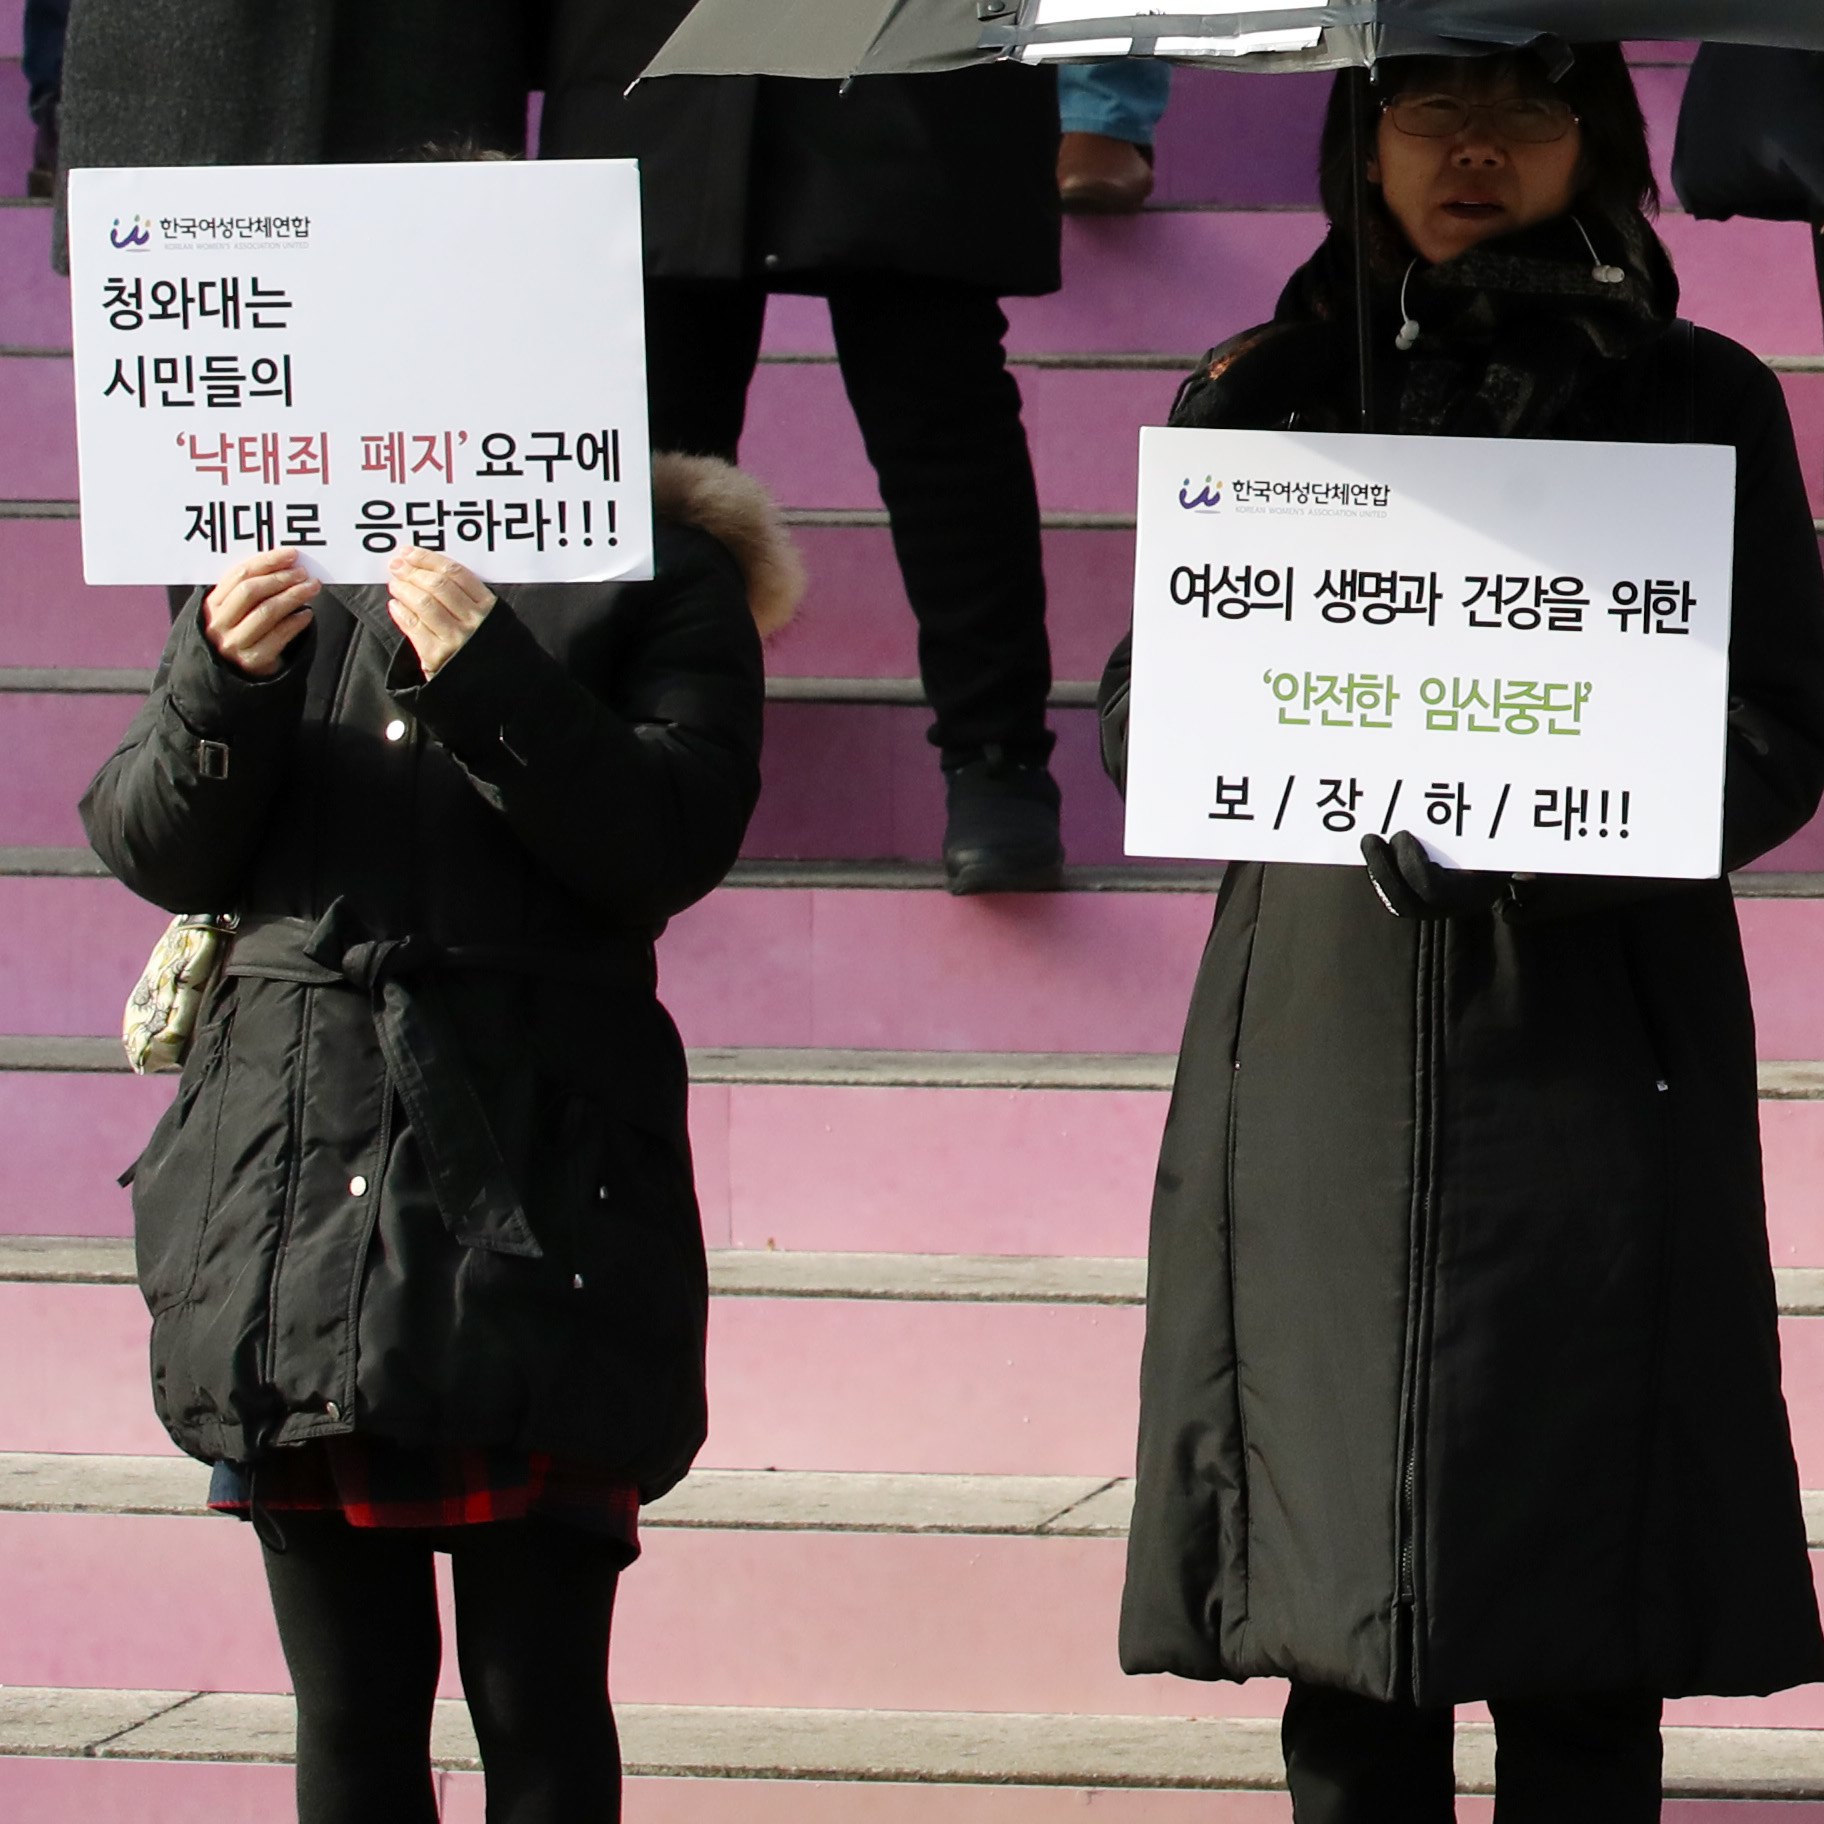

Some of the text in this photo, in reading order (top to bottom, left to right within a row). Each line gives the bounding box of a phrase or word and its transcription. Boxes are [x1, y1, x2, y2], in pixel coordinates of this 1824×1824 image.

[160, 216, 311, 239] 한국여성단체연합
[102, 275, 293, 330] 청와대는
[103, 354, 293, 408] 시민들의
[1232, 480, 1390, 506] 한국여성단체연합
[184, 498, 620, 553] 제대로 응답하라!!!
[1170, 563, 1696, 636] 여성의 생명과 건강을 위한
[1209, 776, 1254, 822] 보
[1315, 777, 1363, 832] 장
[1424, 783, 1471, 836] 하
[1533, 787, 1631, 840] 라!!!
